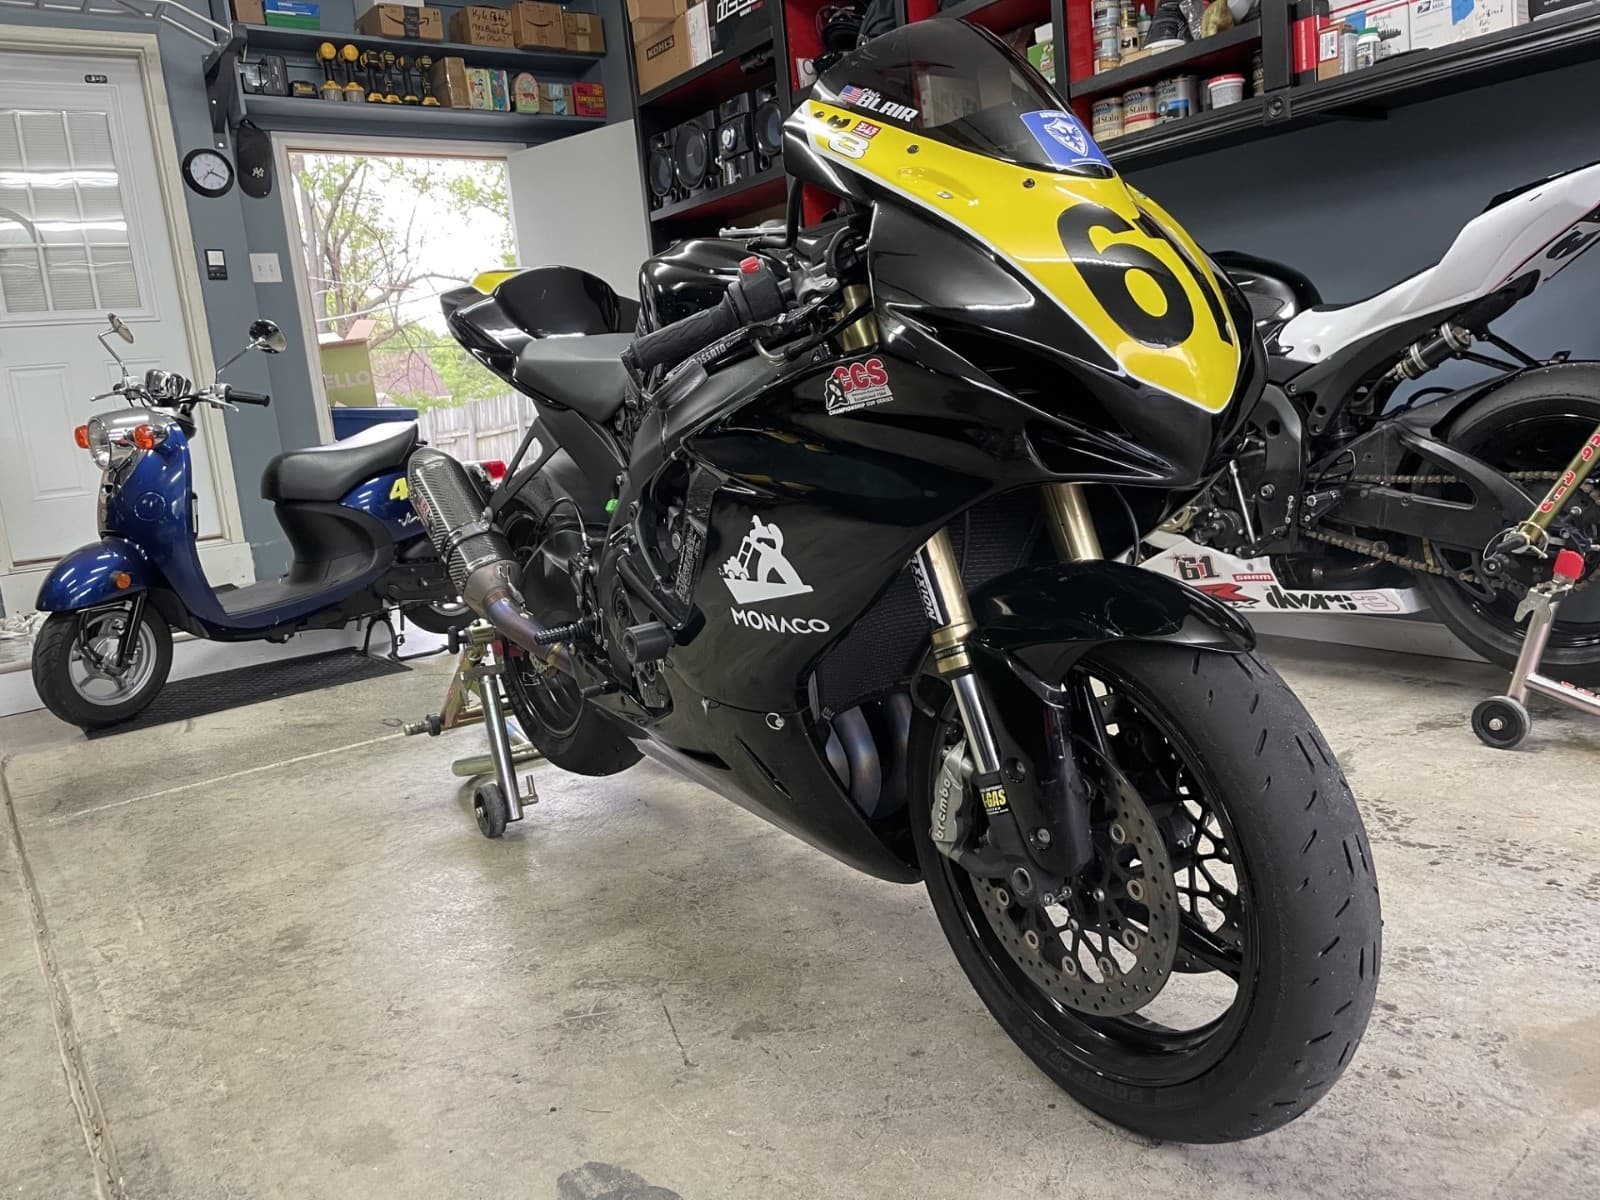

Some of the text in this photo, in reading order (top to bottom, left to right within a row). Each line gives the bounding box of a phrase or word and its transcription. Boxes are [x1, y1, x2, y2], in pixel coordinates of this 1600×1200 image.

[856, 94, 918, 122] BLAIR
[325, 370, 370, 389] ELLO
[833, 358, 889, 393] CCS
[1179, 554, 1219, 580] 61
[730, 607, 831, 634] MONACO
[935, 777, 951, 840] brembo
